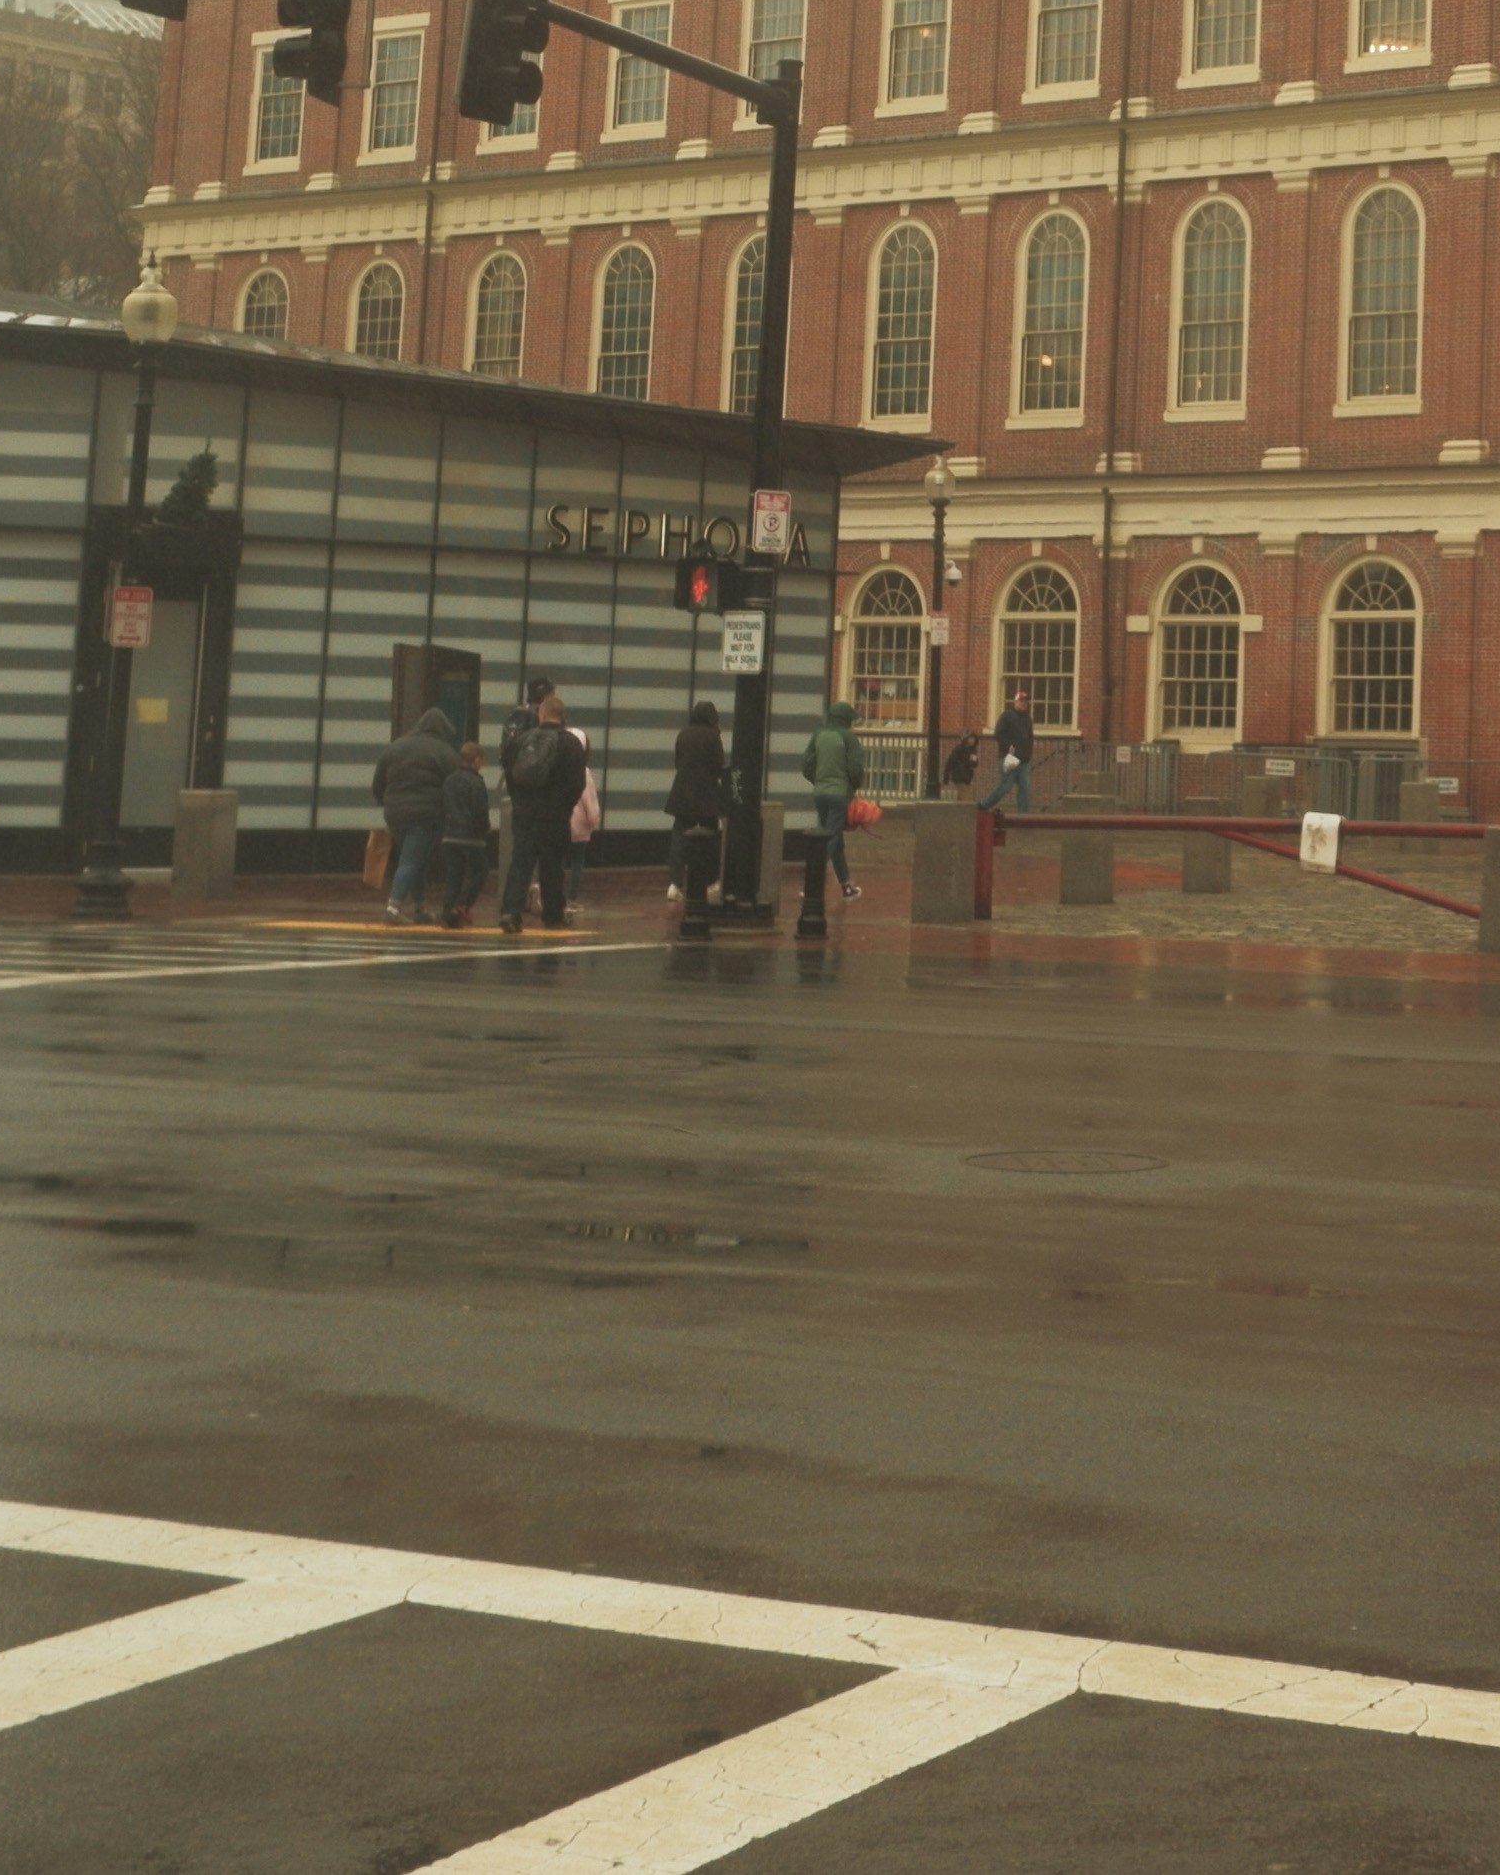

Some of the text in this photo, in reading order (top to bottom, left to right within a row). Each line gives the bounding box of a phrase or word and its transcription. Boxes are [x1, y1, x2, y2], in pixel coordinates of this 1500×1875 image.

[546, 504, 811, 567] SEPHOA
[726, 621, 761, 631] PEDESTRIANS
[733, 632, 752, 641] PLEASE
[730, 643, 755, 652] WAIT FOR
[725, 655, 758, 664] WALK SIGNAL
